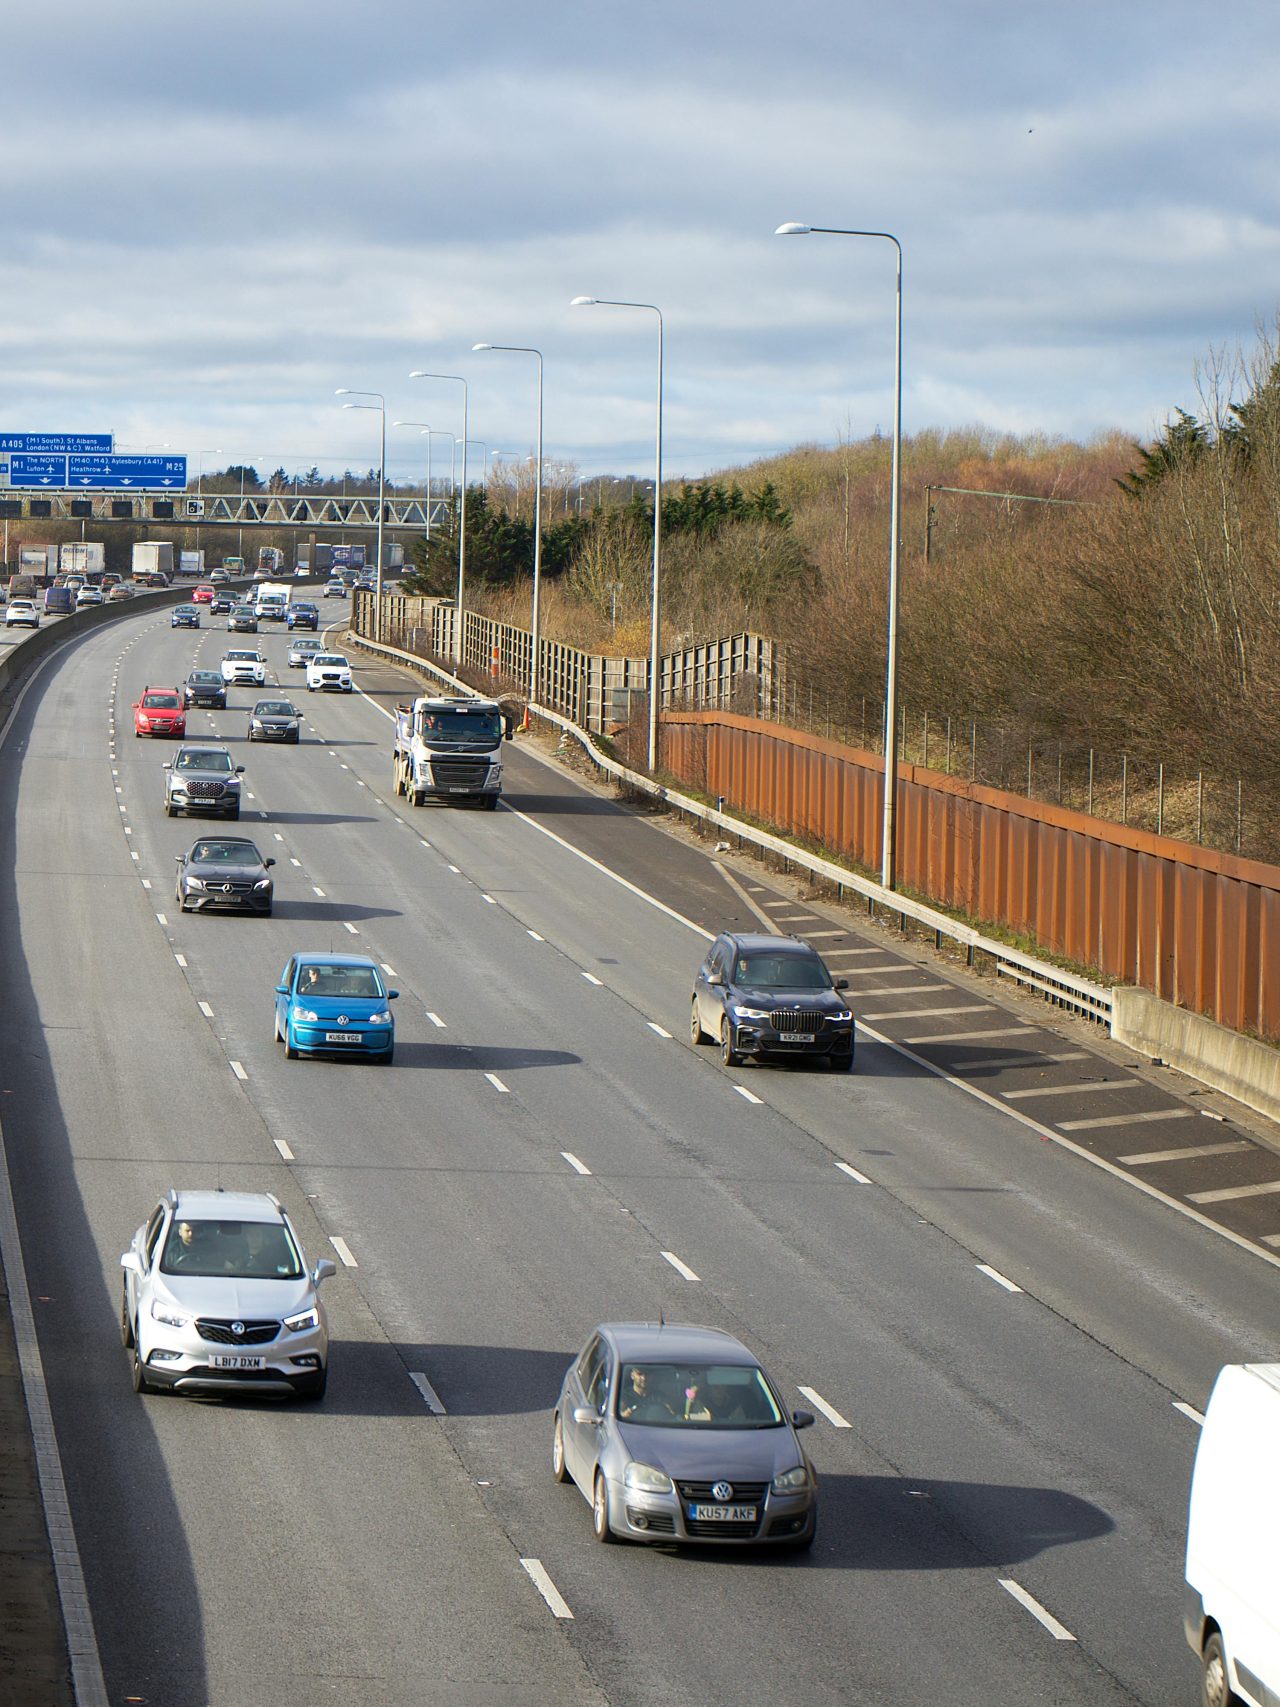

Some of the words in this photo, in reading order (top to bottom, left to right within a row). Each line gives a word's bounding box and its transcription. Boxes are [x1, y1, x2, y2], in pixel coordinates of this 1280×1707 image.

[111, 457, 142, 465] Aylesbury
[166, 462, 184, 471] M25
[214, 1356, 238, 1367] LB17
[240, 1357, 260, 1368] DXM
[698, 1506, 729, 1519] KU57
[732, 1507, 756, 1520] AKF
